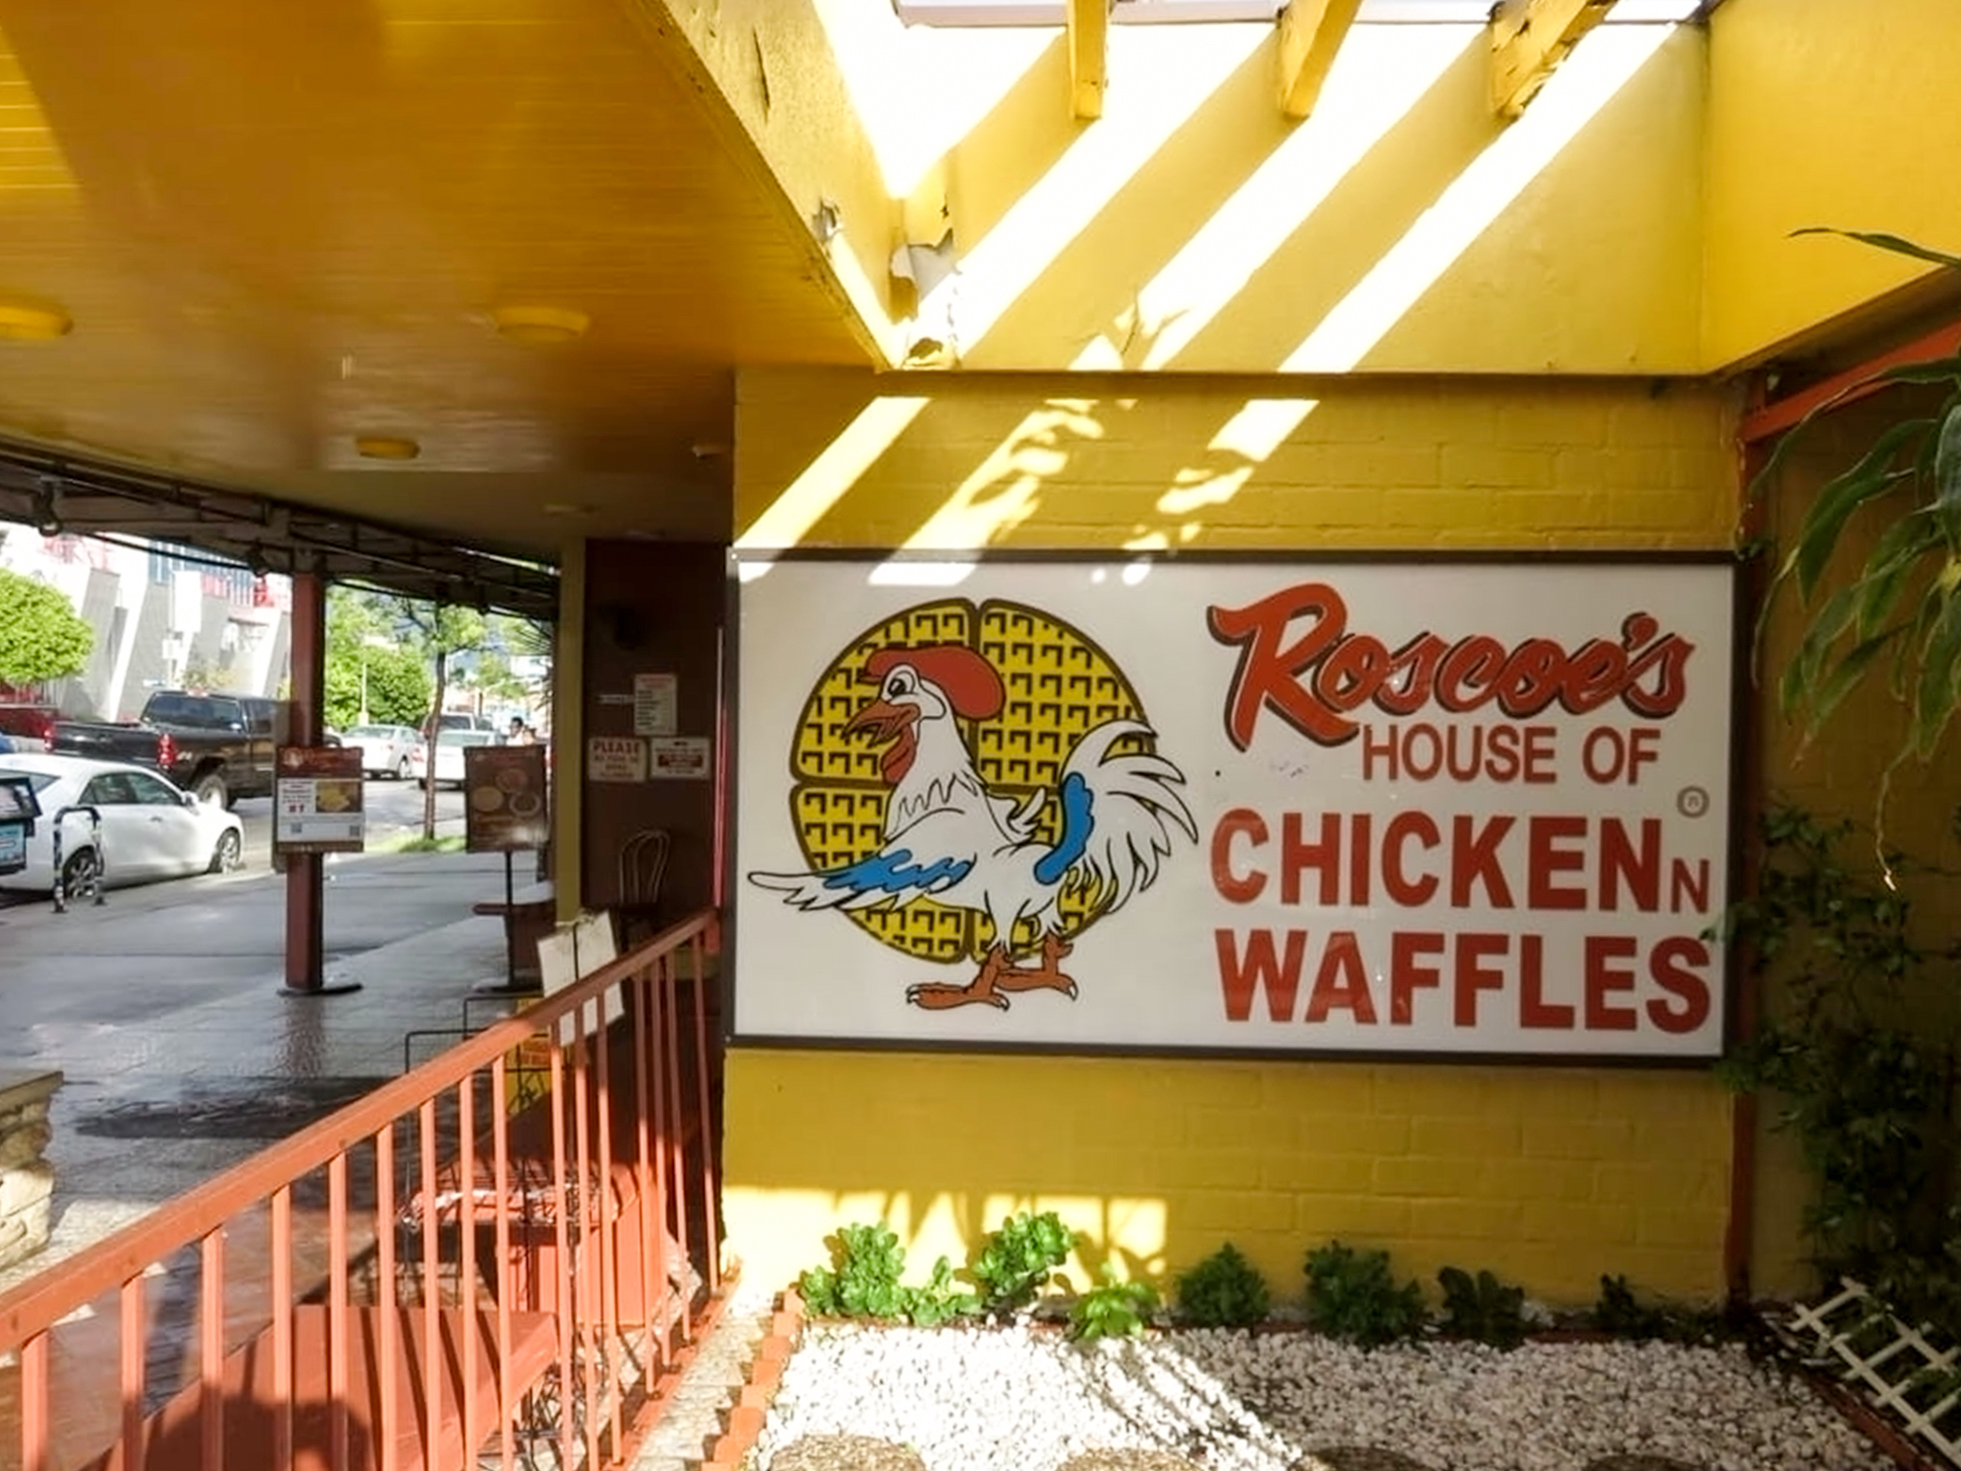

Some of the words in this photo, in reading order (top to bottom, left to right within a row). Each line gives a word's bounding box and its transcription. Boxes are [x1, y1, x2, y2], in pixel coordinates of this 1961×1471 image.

[1207, 582, 1695, 752] Roscoe's
[593, 740, 640, 754] PLEASE
[1361, 723, 1557, 783] HOUSE
[1582, 726, 1661, 786] OF
[1210, 807, 1662, 913] CHICKEN
[1669, 858, 1710, 914] N
[1214, 929, 1711, 1034] WAFFLES
